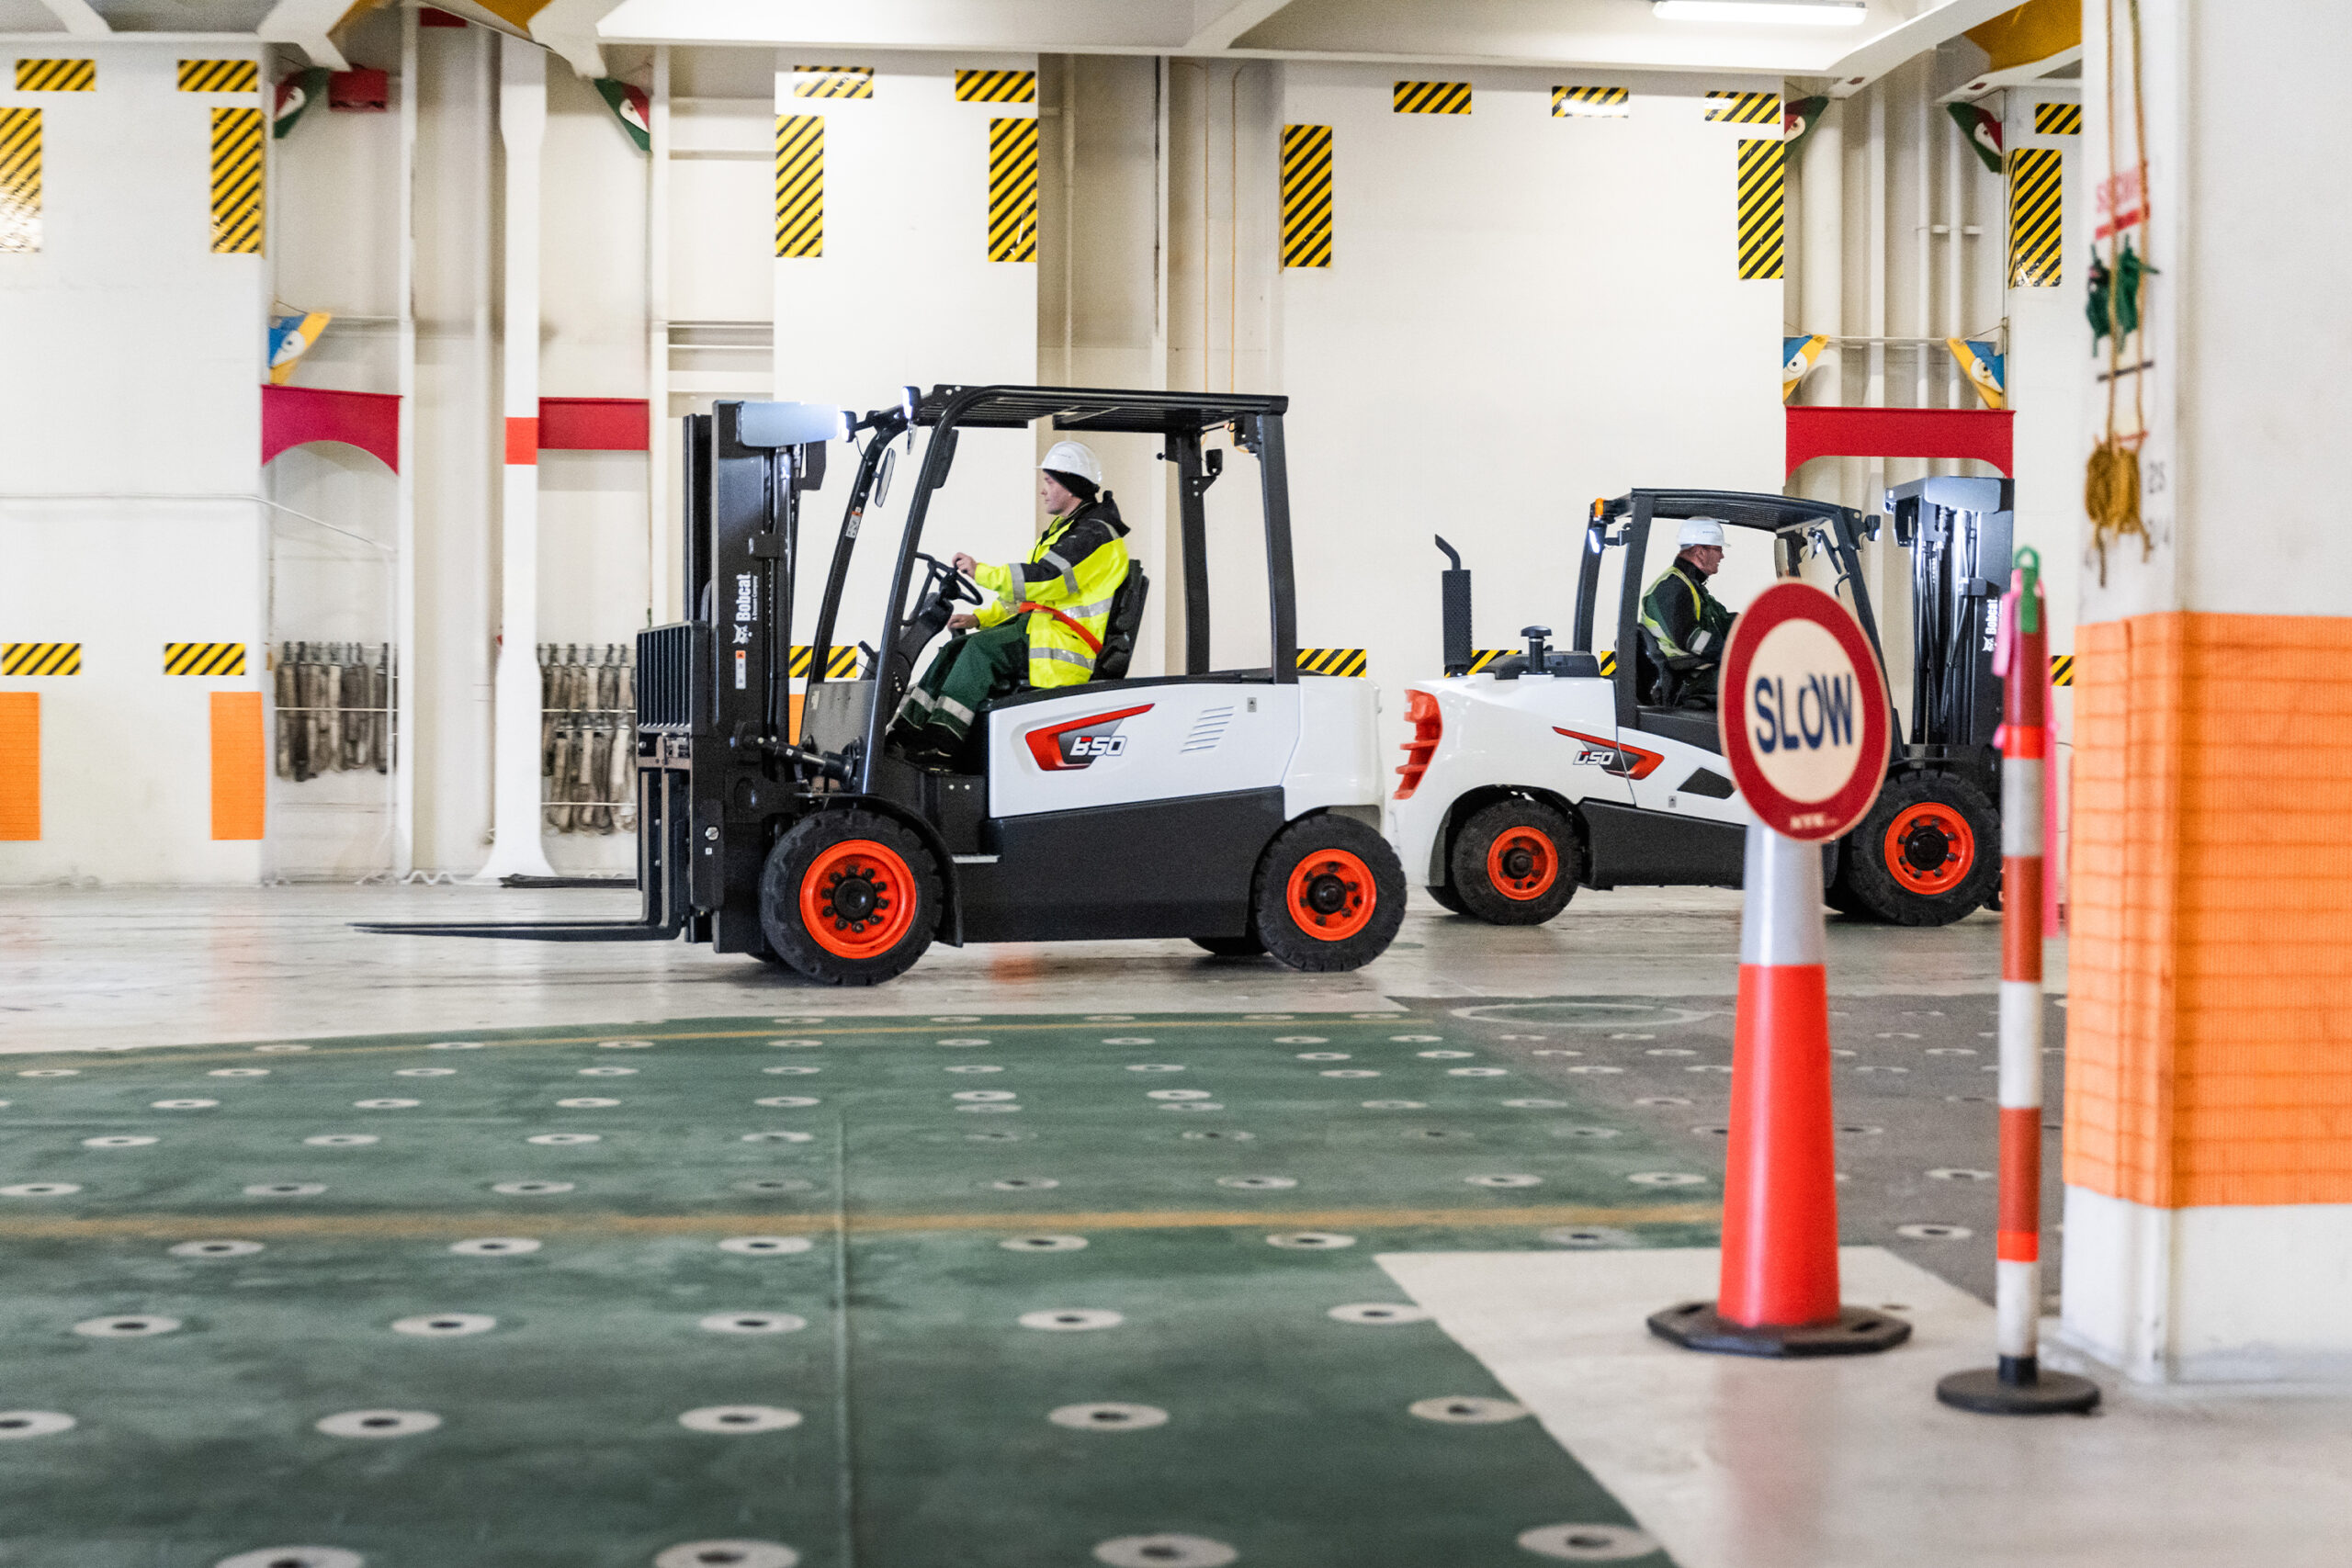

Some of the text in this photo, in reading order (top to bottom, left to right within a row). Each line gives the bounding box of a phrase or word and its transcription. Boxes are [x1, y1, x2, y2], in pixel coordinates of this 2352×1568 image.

[735, 573, 752, 622] Bobcat
[1984, 598, 1998, 635] Bobcat
[1754, 672, 1852, 754] SLOW
